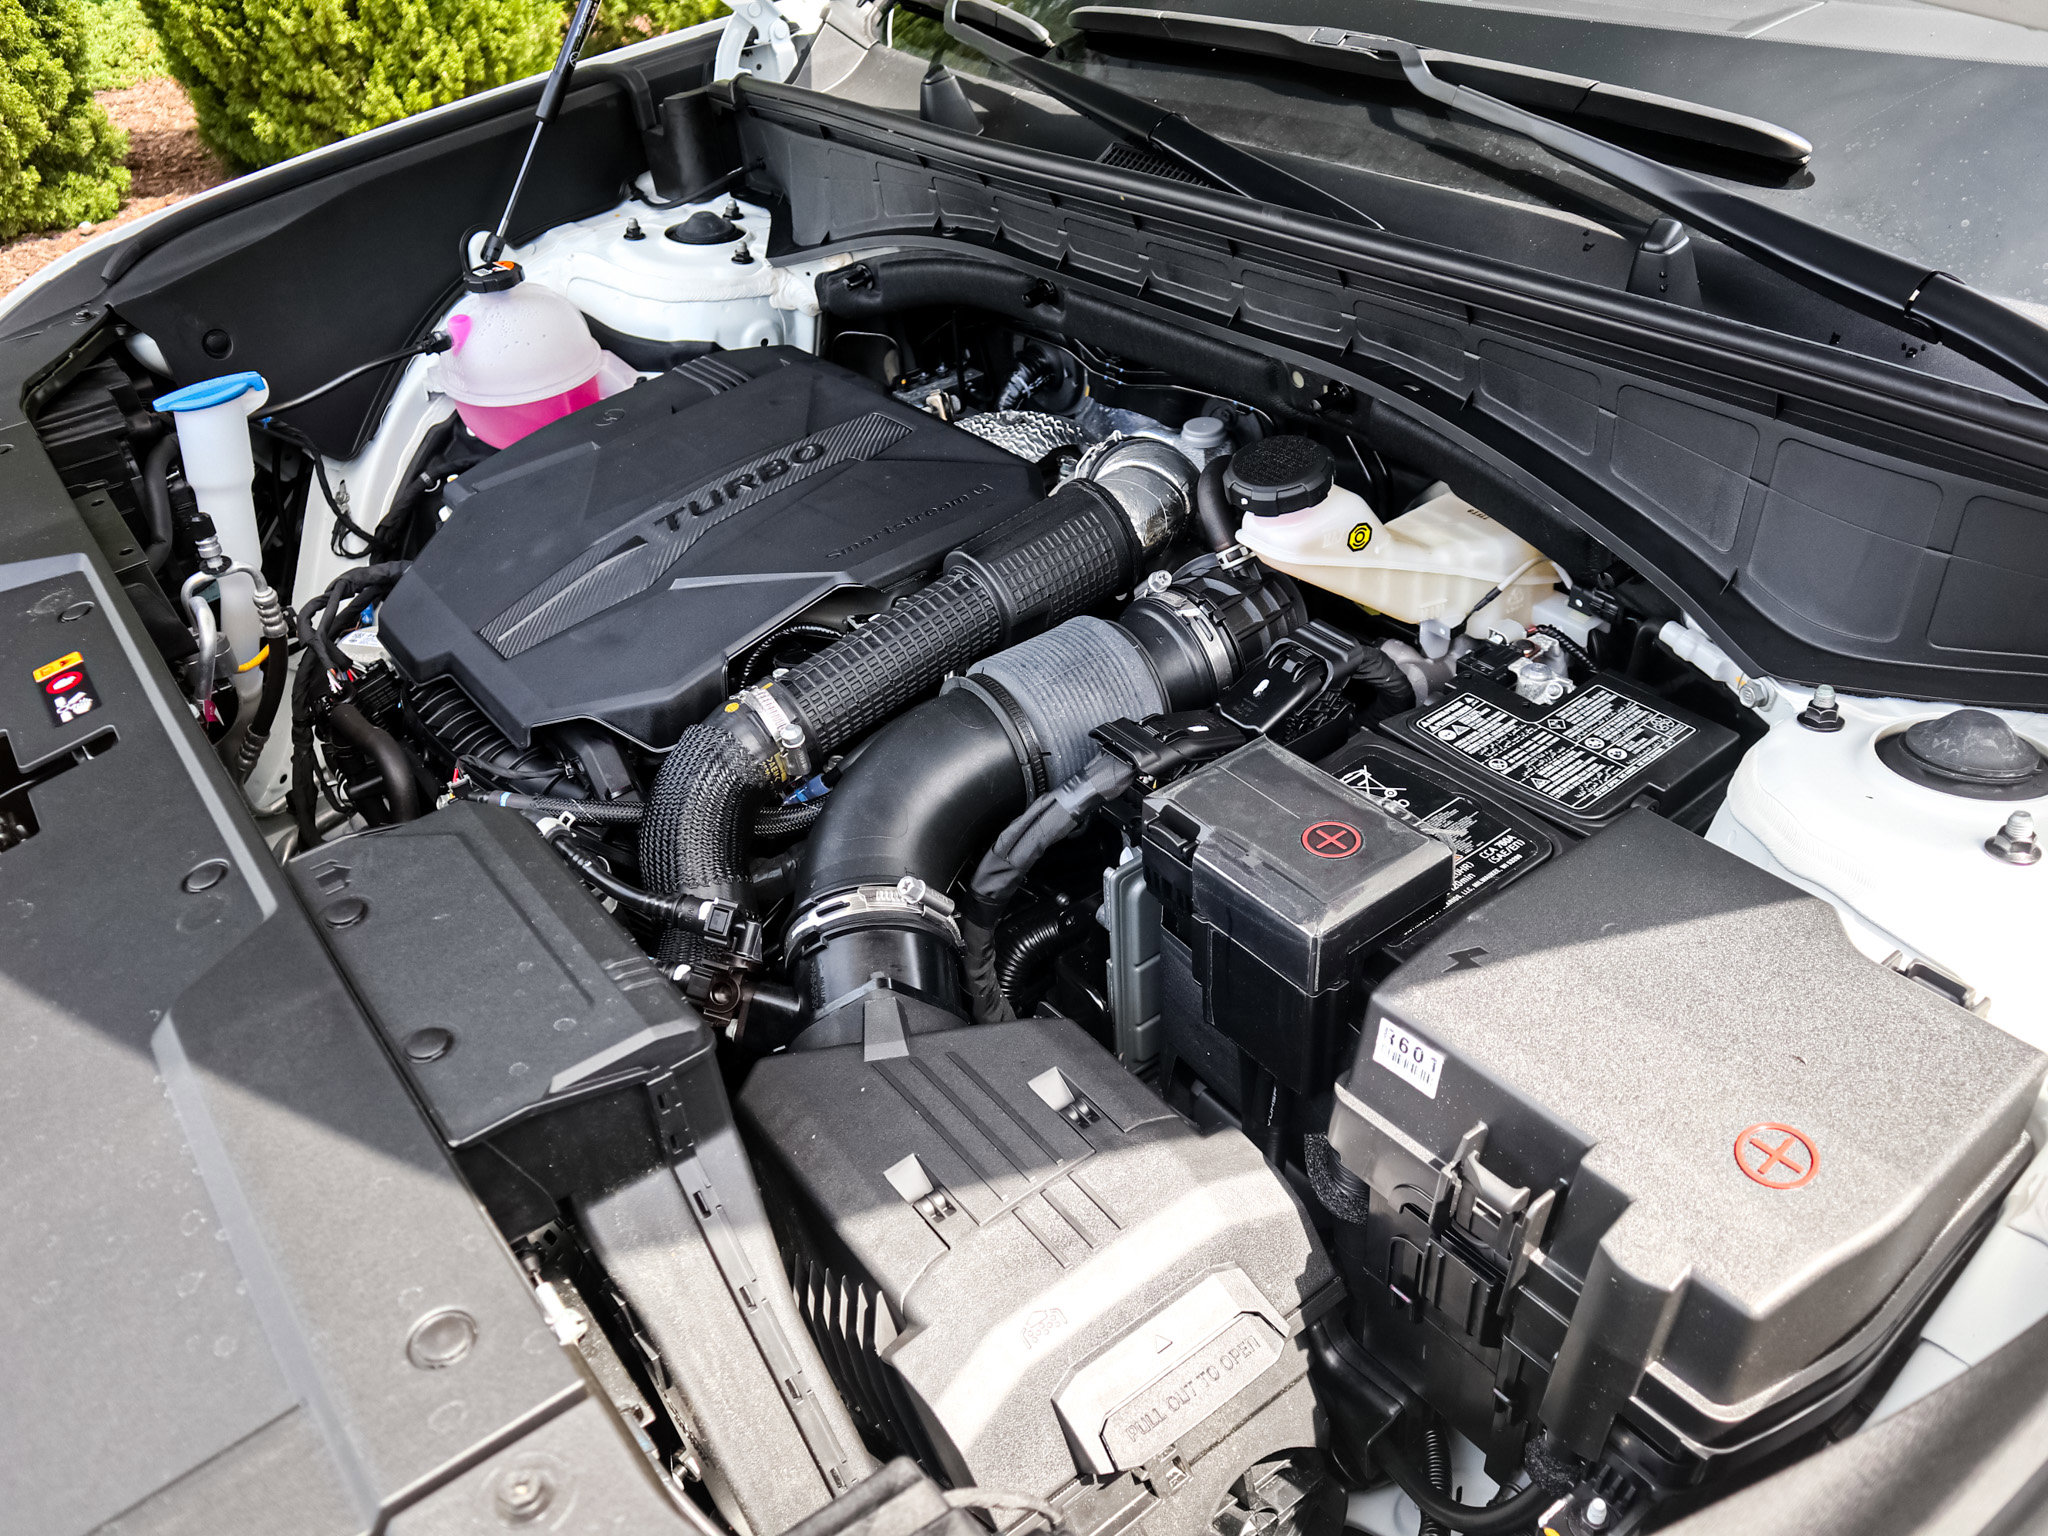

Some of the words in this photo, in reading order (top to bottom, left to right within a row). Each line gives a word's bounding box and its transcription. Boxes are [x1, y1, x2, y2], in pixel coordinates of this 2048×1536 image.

[653, 443, 824, 533] TURBO
[1479, 846, 1498, 859] CCA
[1124, 1409, 1168, 1443] PULL
[1167, 1380, 1199, 1412] OUT
[1196, 1363, 1221, 1389] TO
[1219, 1335, 1262, 1372] OPEN
